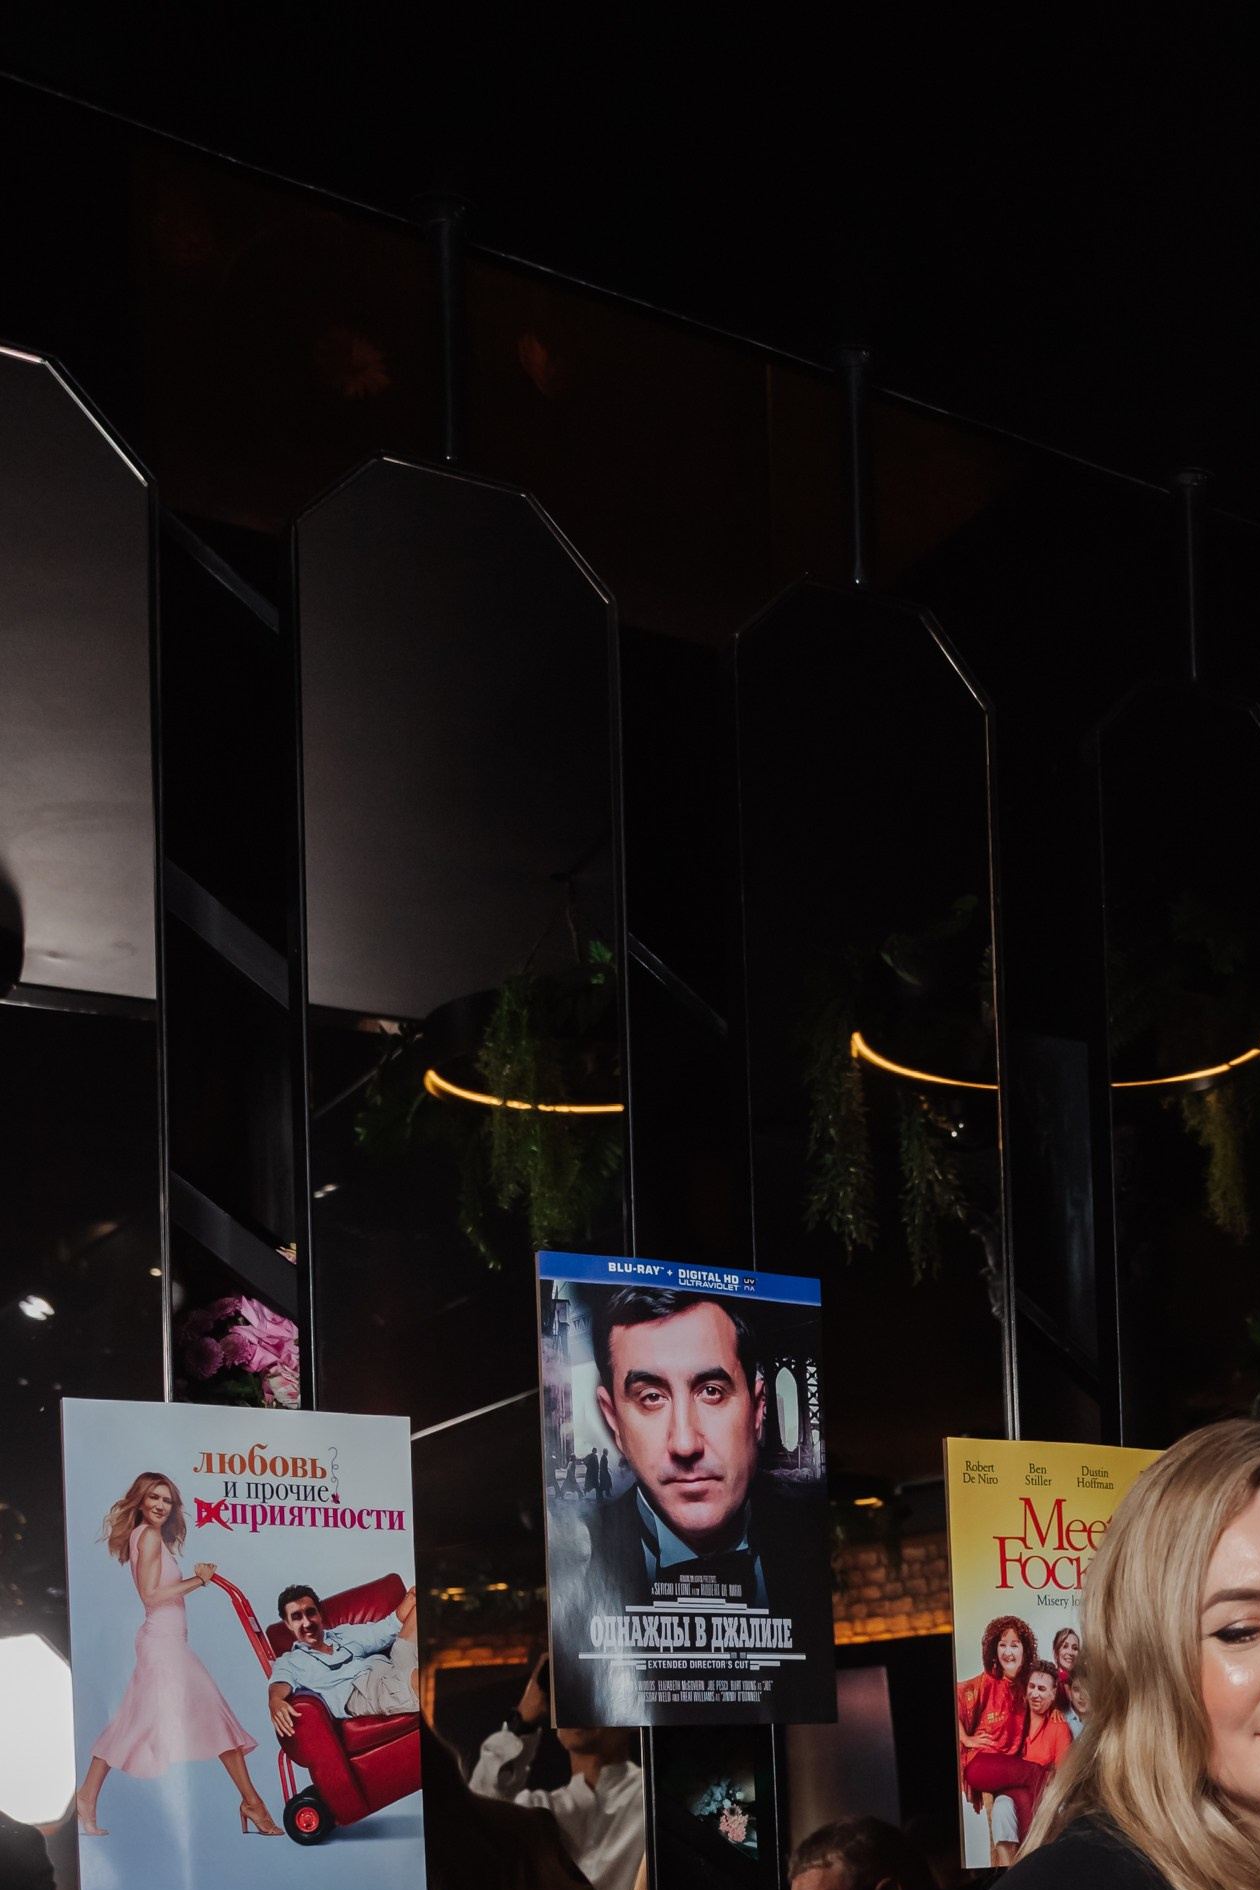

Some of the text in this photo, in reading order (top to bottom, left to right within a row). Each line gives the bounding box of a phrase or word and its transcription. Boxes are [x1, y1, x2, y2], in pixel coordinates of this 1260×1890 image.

[678, 1269, 721, 1283] DIGITAL
[724, 1274, 739, 1285] HD
[678, 1278, 738, 1292] ULTRAVIOLET
[193, 1443, 328, 1480] любовь
[965, 1461, 995, 1473] Robert
[1028, 1463, 1047, 1475] Ben
[1081, 1466, 1109, 1478] Dustin
[963, 1473, 998, 1485] De Niro
[1025, 1475, 1052, 1486] Stiller
[1077, 1477, 1114, 1490] Hoffman
[223, 1480, 330, 1504] и прочие
[1019, 1497, 1113, 1552] Mee
[1037, 1594, 1069, 1609] Misery
[590, 1615, 793, 1653] ОДНАЖДЫ В ДЖАЛИЛЕ
[648, 1660, 749, 1669] EXTENDED DIRECTOR'S CUT
